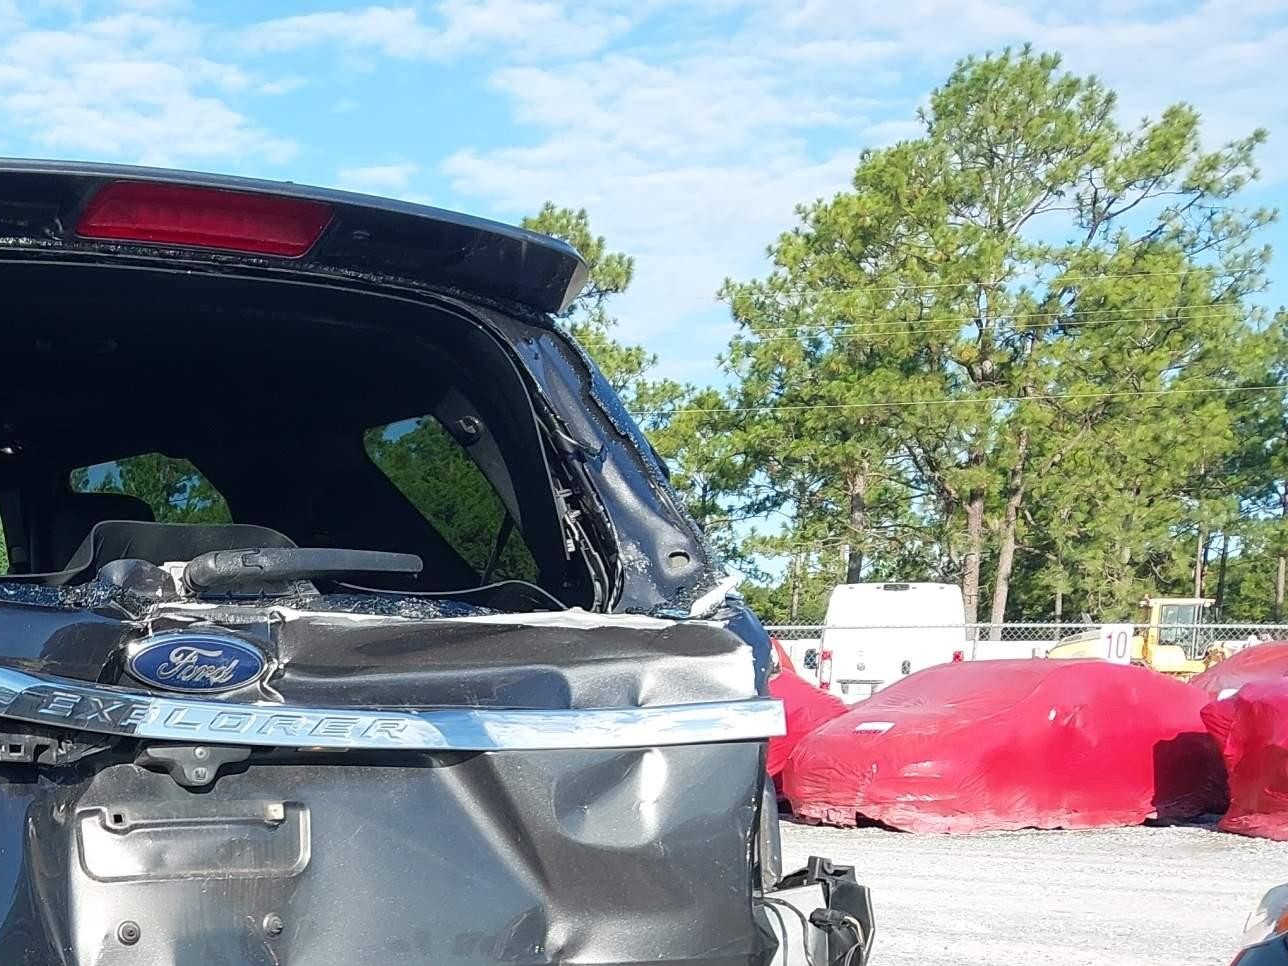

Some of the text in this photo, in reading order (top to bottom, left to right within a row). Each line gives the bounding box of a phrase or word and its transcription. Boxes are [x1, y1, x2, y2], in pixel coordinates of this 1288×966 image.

[1106, 631, 1128, 659] 10
[156, 646, 239, 684] Ford
[38, 691, 409, 739] EXPLORER
